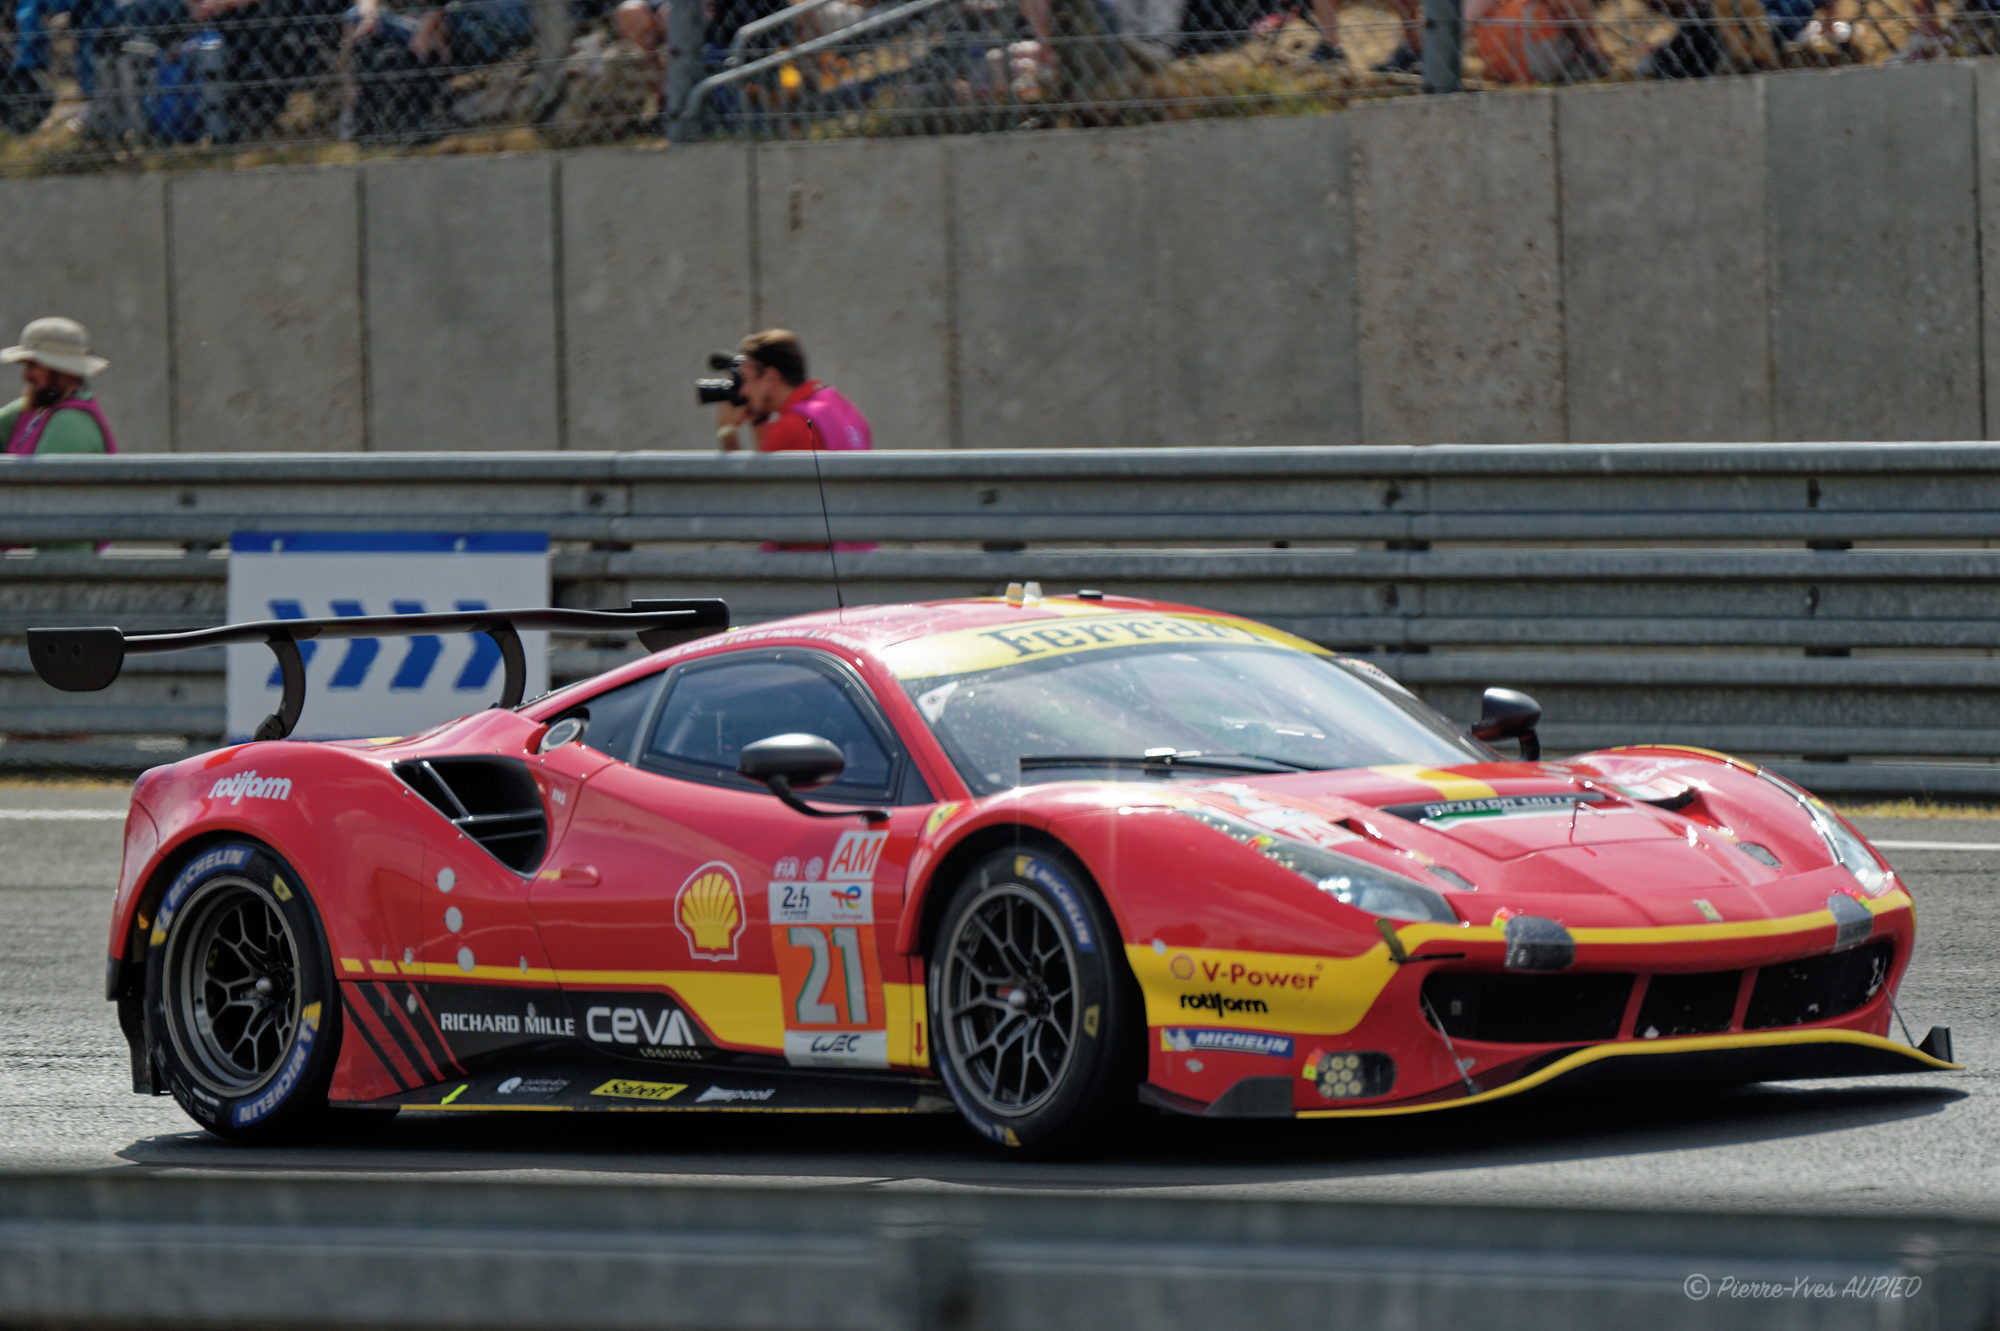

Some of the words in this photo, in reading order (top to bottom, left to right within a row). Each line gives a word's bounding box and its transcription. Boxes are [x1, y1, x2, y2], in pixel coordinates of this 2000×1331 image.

[208, 769, 292, 805] rotiform
[832, 838, 885, 873] AM
[788, 926, 869, 1024] 21
[1202, 961, 1320, 990] V-Power
[1180, 993, 1268, 1018] rotiform
[440, 1012, 520, 1034] RICHARD
[525, 1015, 575, 1036] MILLE
[640, 1048, 702, 1060] LOGISTICS
[811, 1033, 861, 1053] WEC
[1195, 1032, 1289, 1053] MICHELIN
